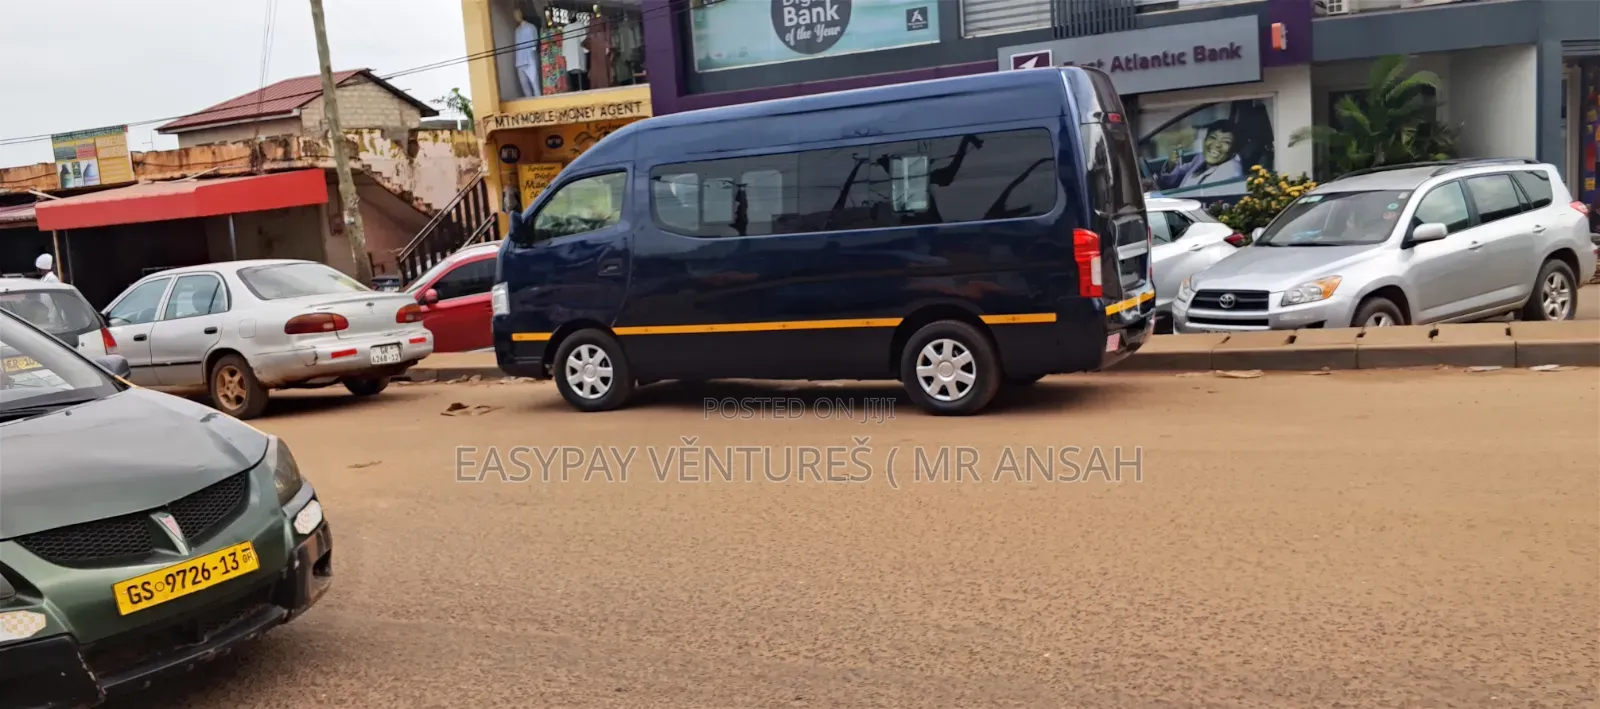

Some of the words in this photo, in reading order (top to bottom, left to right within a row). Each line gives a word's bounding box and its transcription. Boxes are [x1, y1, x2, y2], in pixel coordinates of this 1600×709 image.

[783, 0, 840, 27] Bank
[785, 28, 795, 46] of
[796, 26, 812, 41] the
[814, 24, 842, 43] Year
[1110, 51, 1187, 73] Atlantic
[1193, 41, 1243, 64] Bank
[559, 105, 596, 121] MONEY
[600, 101, 643, 117] AGENT
[126, 581, 155, 605] GS
[164, 551, 240, 593] 9726-13
